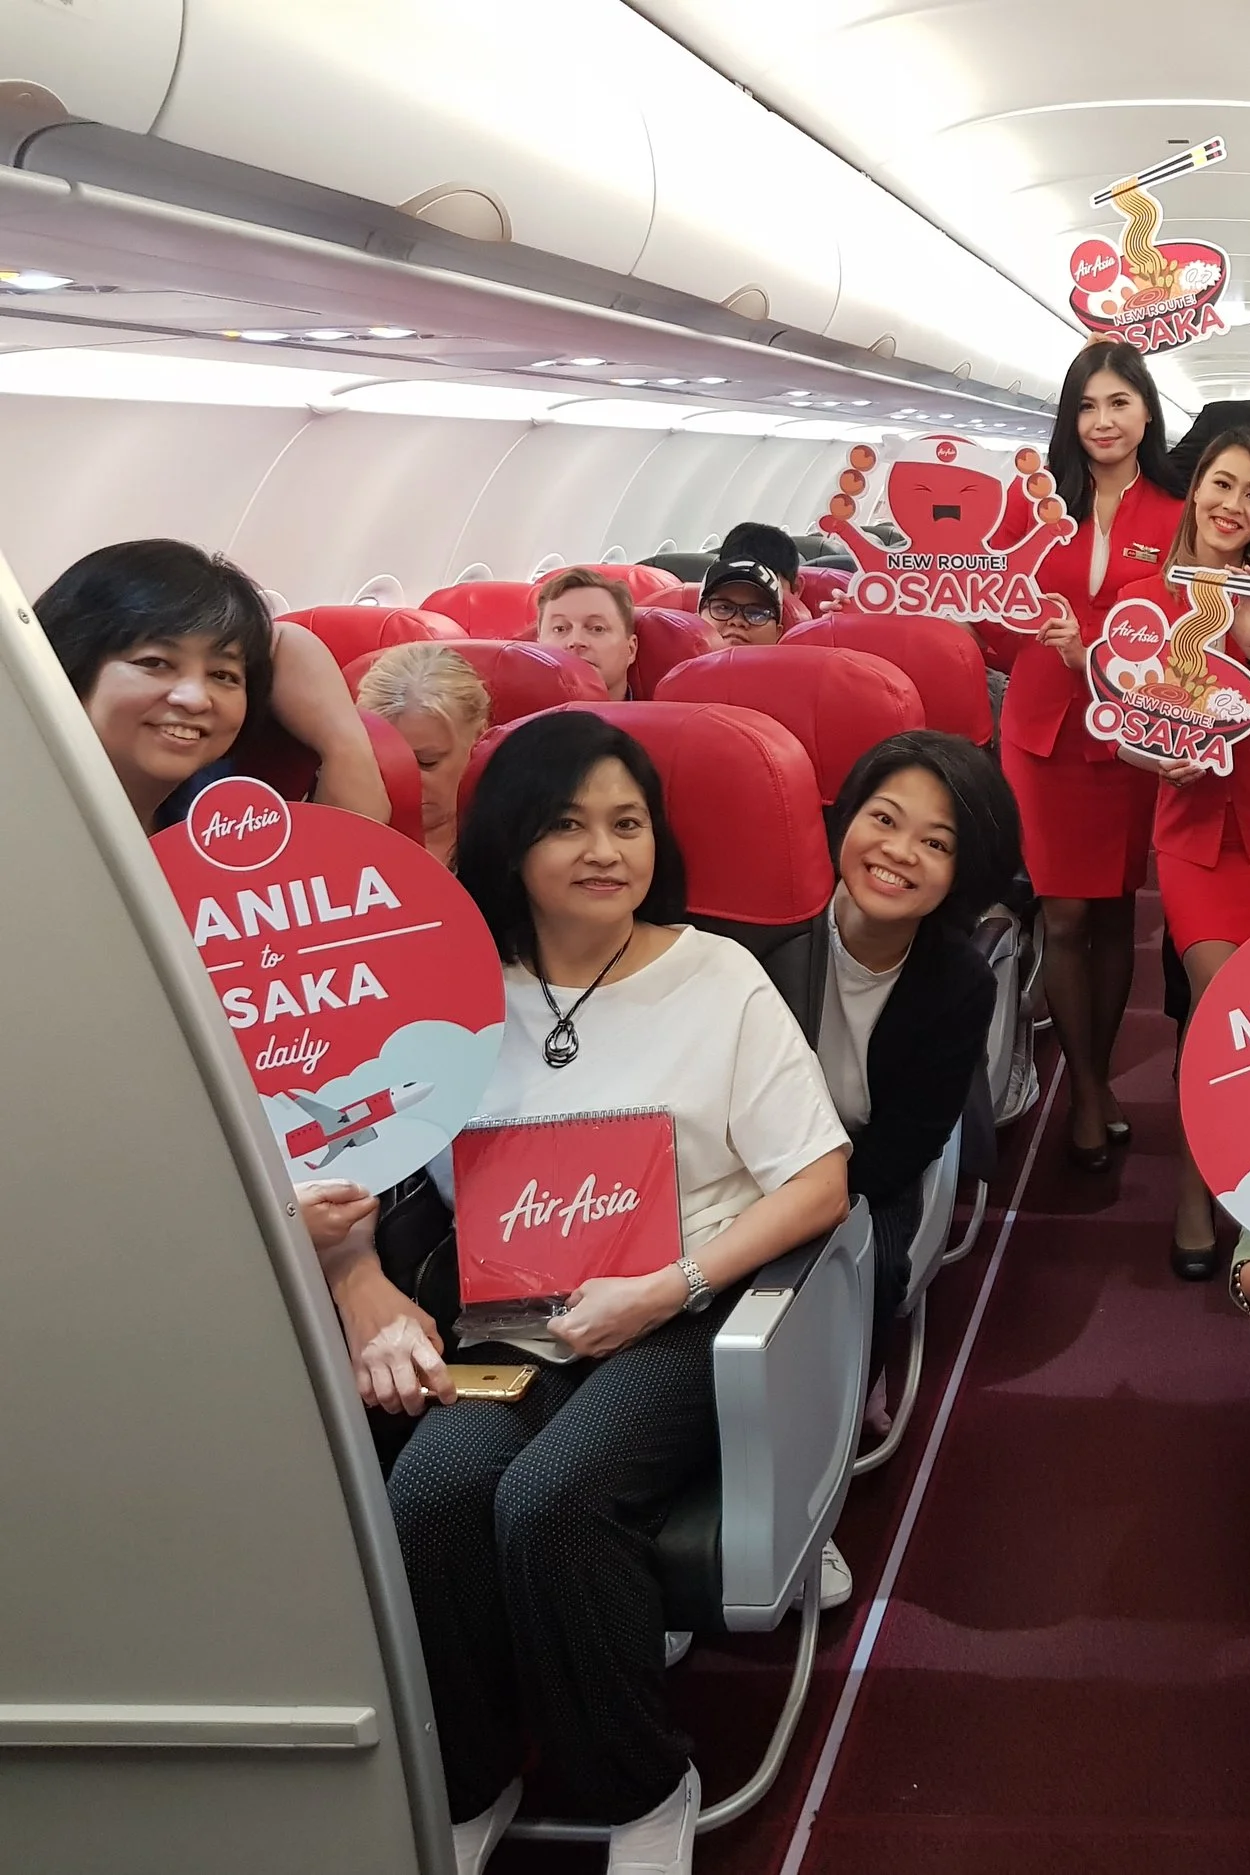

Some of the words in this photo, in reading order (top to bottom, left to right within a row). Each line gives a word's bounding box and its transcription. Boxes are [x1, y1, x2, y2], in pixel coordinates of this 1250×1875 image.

[1074, 256, 1116, 281] AirAsia
[1115, 307, 1145, 324] NEW
[1149, 295, 1196, 315] ROUTE!
[888, 555, 931, 568] NEW
[938, 555, 1007, 569] ROUTE!
[858, 574, 1038, 613] OSAKA
[1111, 620, 1159, 643] AirAsia
[1122, 691, 1160, 711] NEW
[1161, 703, 1215, 728] ROUTE!
[1093, 703, 1227, 769] OSAKA
[201, 805, 280, 846] AirAsia
[193, 866, 402, 947] ANILA
[261, 944, 285, 969] to
[222, 963, 389, 1030] SAKA
[256, 1028, 330, 1075] daily
[499, 1174, 641, 1243] AirAsia
